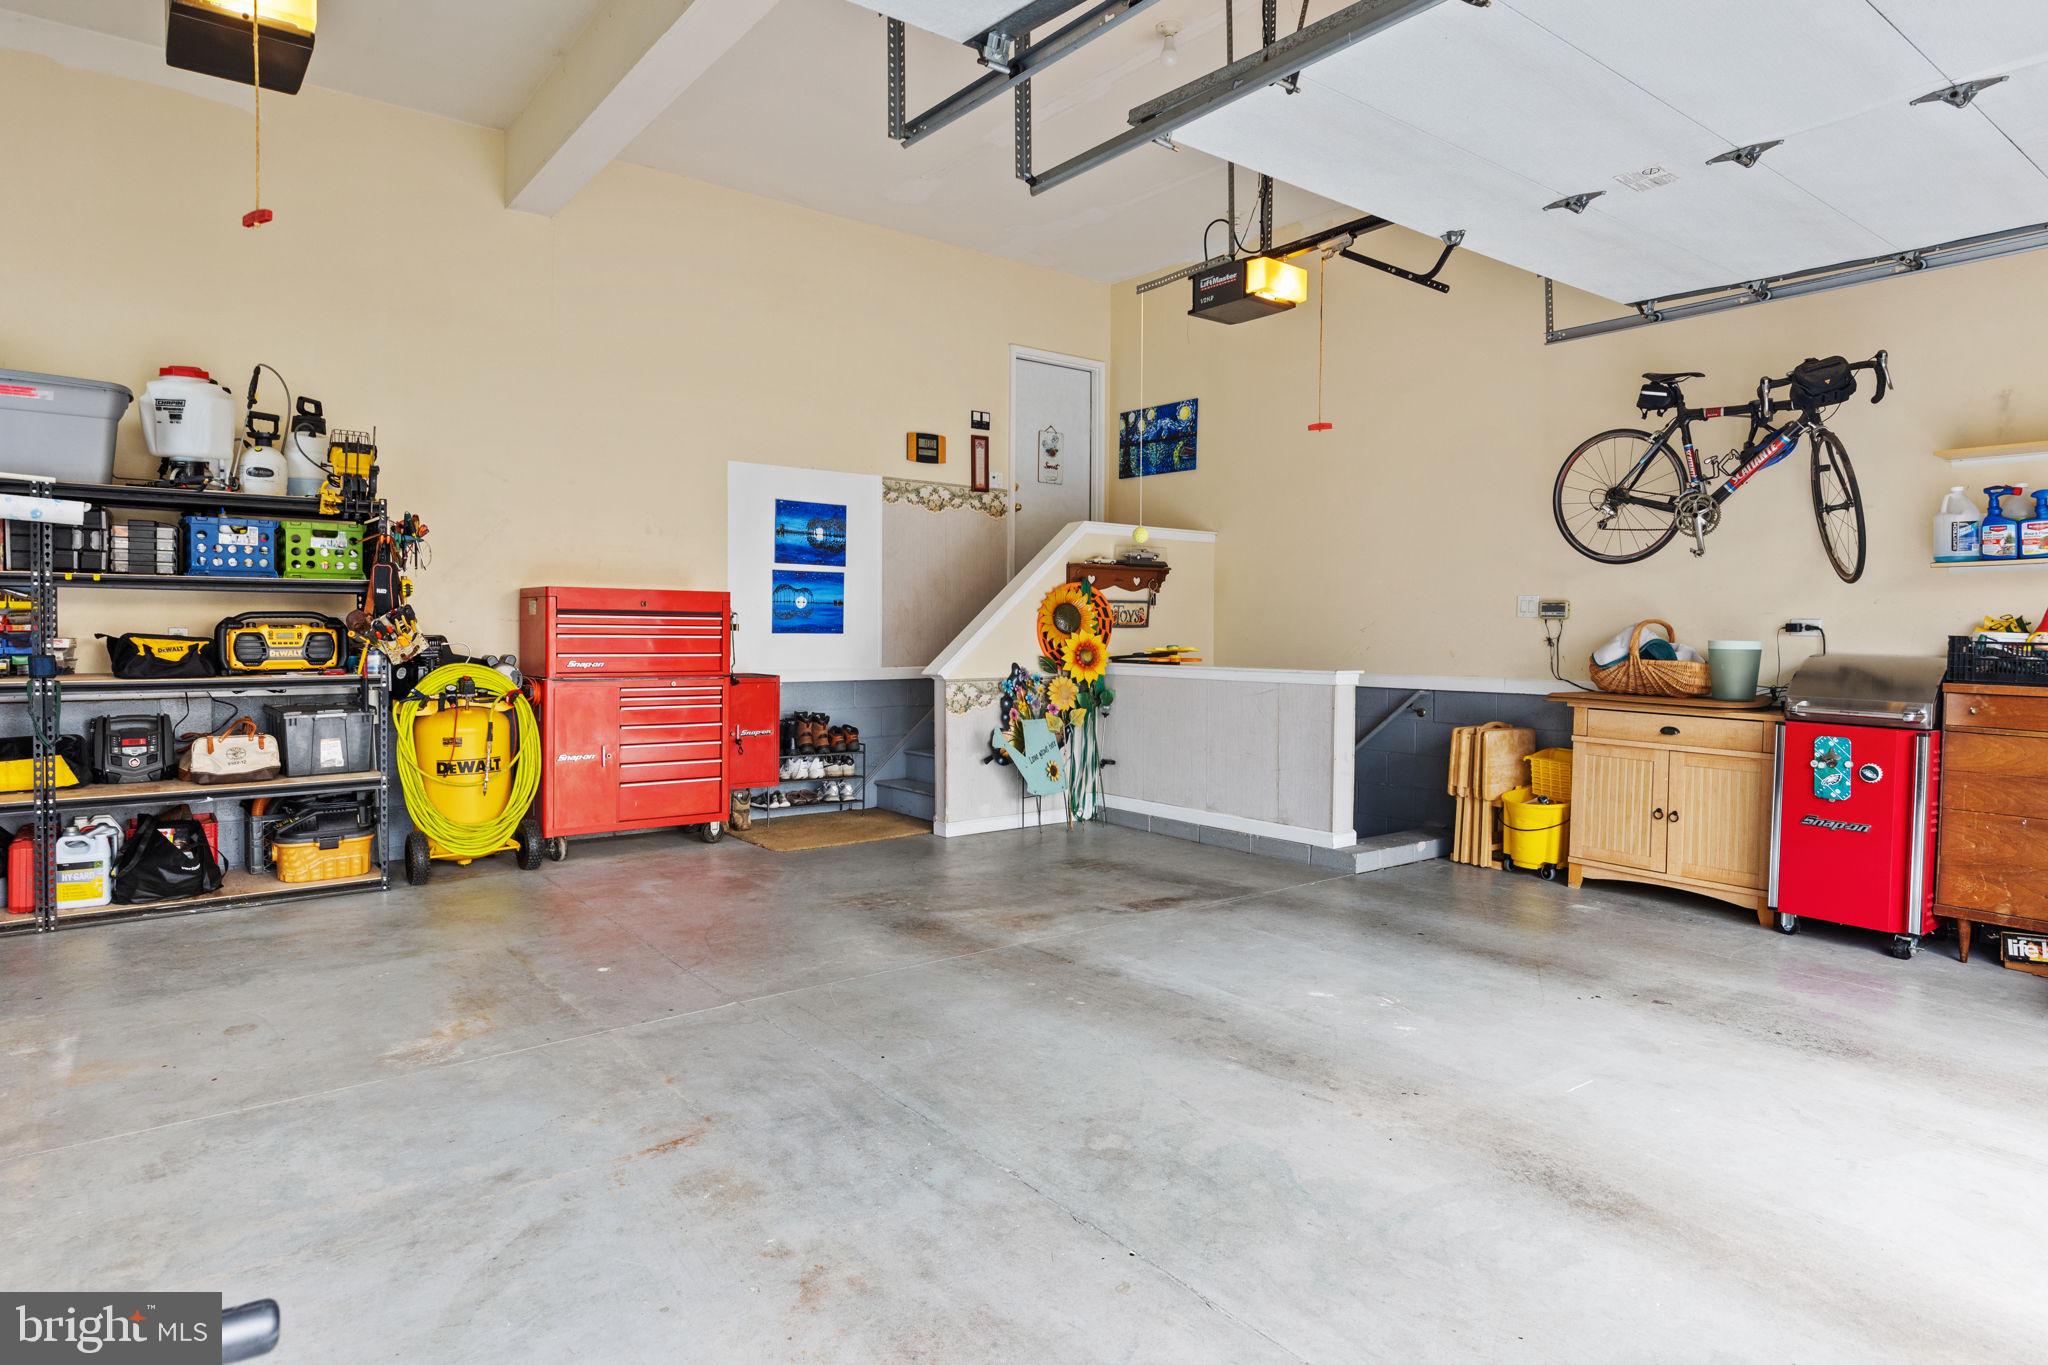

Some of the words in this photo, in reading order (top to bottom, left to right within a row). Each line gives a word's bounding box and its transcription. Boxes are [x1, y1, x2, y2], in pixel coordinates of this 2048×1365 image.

[1200, 273, 1238, 288] LiftMaster
[1113, 605, 1140, 624] TOYS
[567, 660, 605, 668] Snap-on
[1801, 815, 1872, 832] Snap-on
